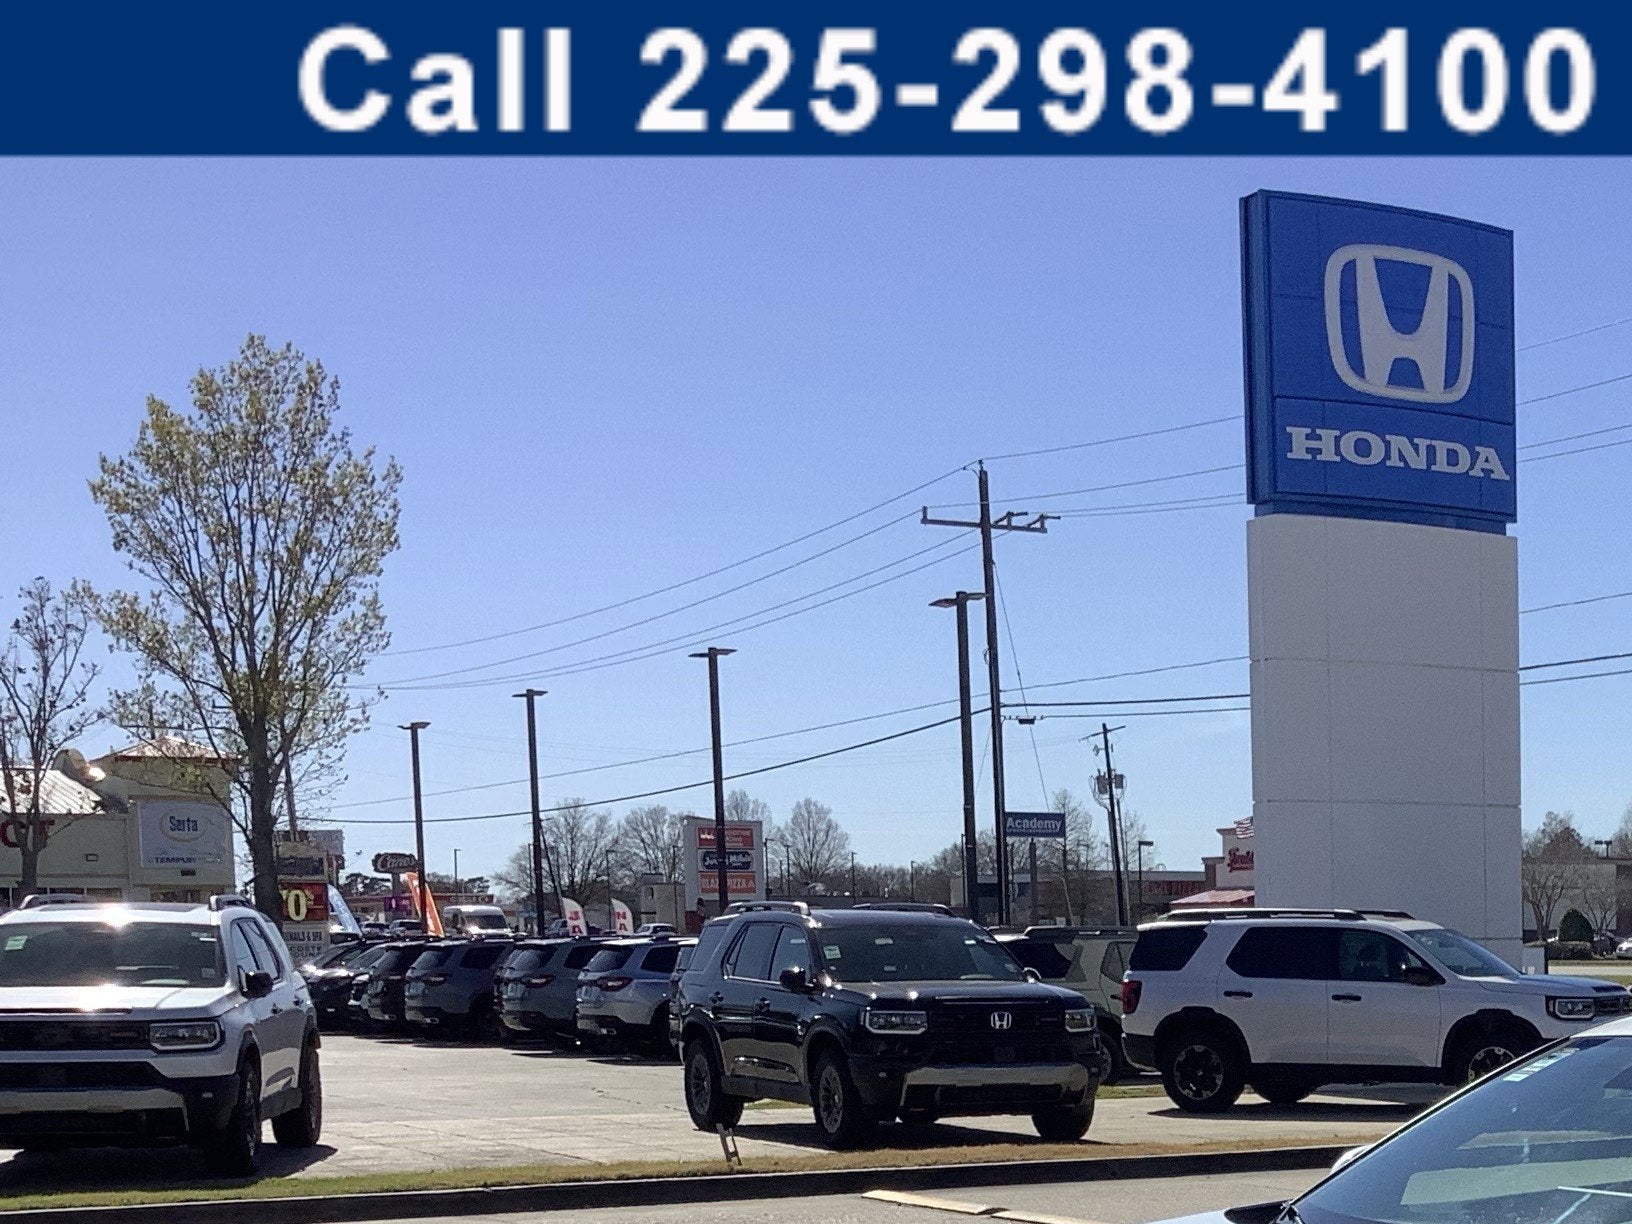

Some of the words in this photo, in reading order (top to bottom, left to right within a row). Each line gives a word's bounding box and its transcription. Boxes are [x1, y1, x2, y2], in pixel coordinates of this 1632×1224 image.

[1286, 426, 1510, 481] HONDA
[169, 815, 198, 832] Serta
[1006, 816, 1062, 832] Academy
